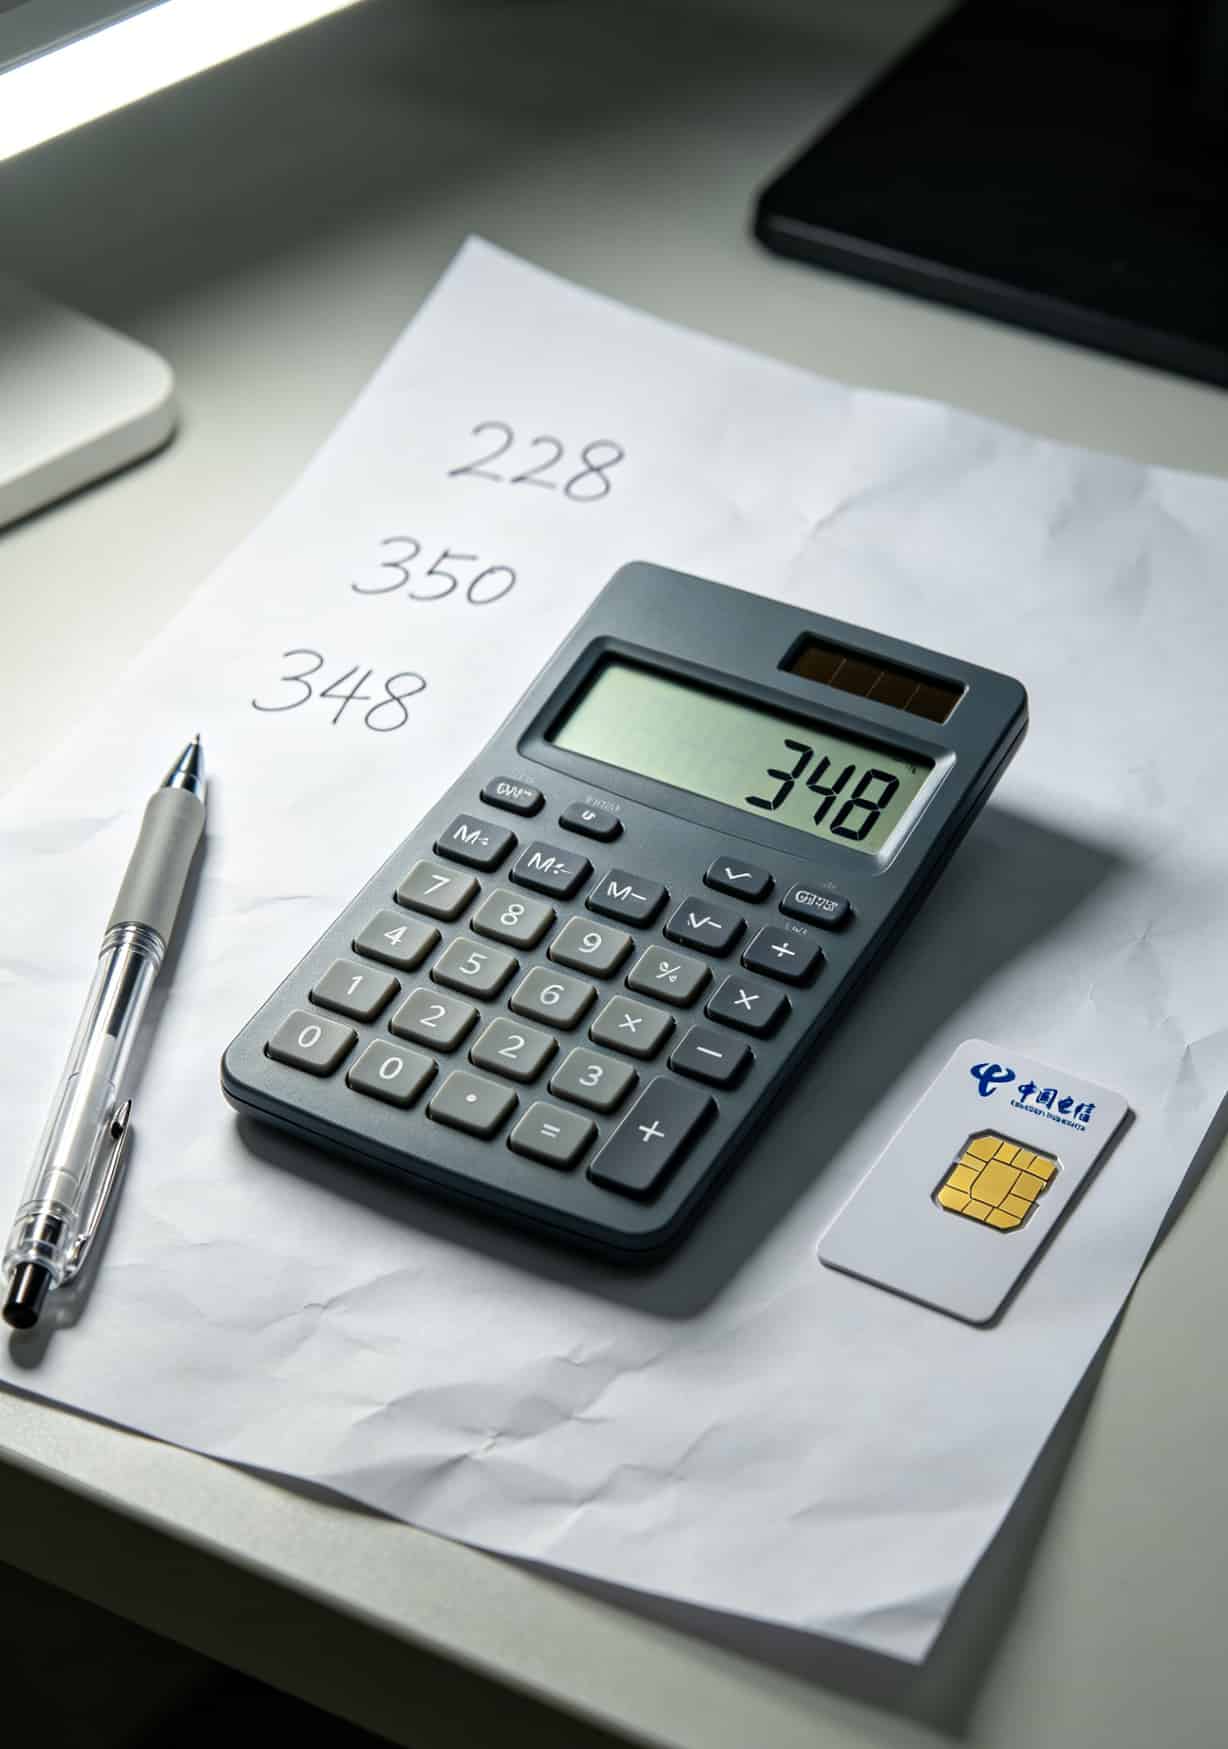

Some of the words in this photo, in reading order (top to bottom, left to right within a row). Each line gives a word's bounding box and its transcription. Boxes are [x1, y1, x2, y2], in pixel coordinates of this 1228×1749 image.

[447, 421, 625, 502] 228
[351, 536, 517, 605] 350
[251, 649, 428, 732] 348
[745, 739, 900, 841] 348
[424, 874, 451, 895] 7
[500, 903, 525, 926] 8
[383, 926, 408, 946] 4
[578, 933, 602, 953] 9
[459, 953, 488, 975] 5
[347, 975, 364, 995] 1
[539, 984, 565, 1005] 6
[419, 1005, 446, 1028] 2
[298, 1025, 321, 1048] 0
[497, 1034, 525, 1059] 2
[379, 1056, 403, 1080] 0
[578, 1065, 604, 1087] 3
[1018, 1080, 1097, 1123] 中国电信
